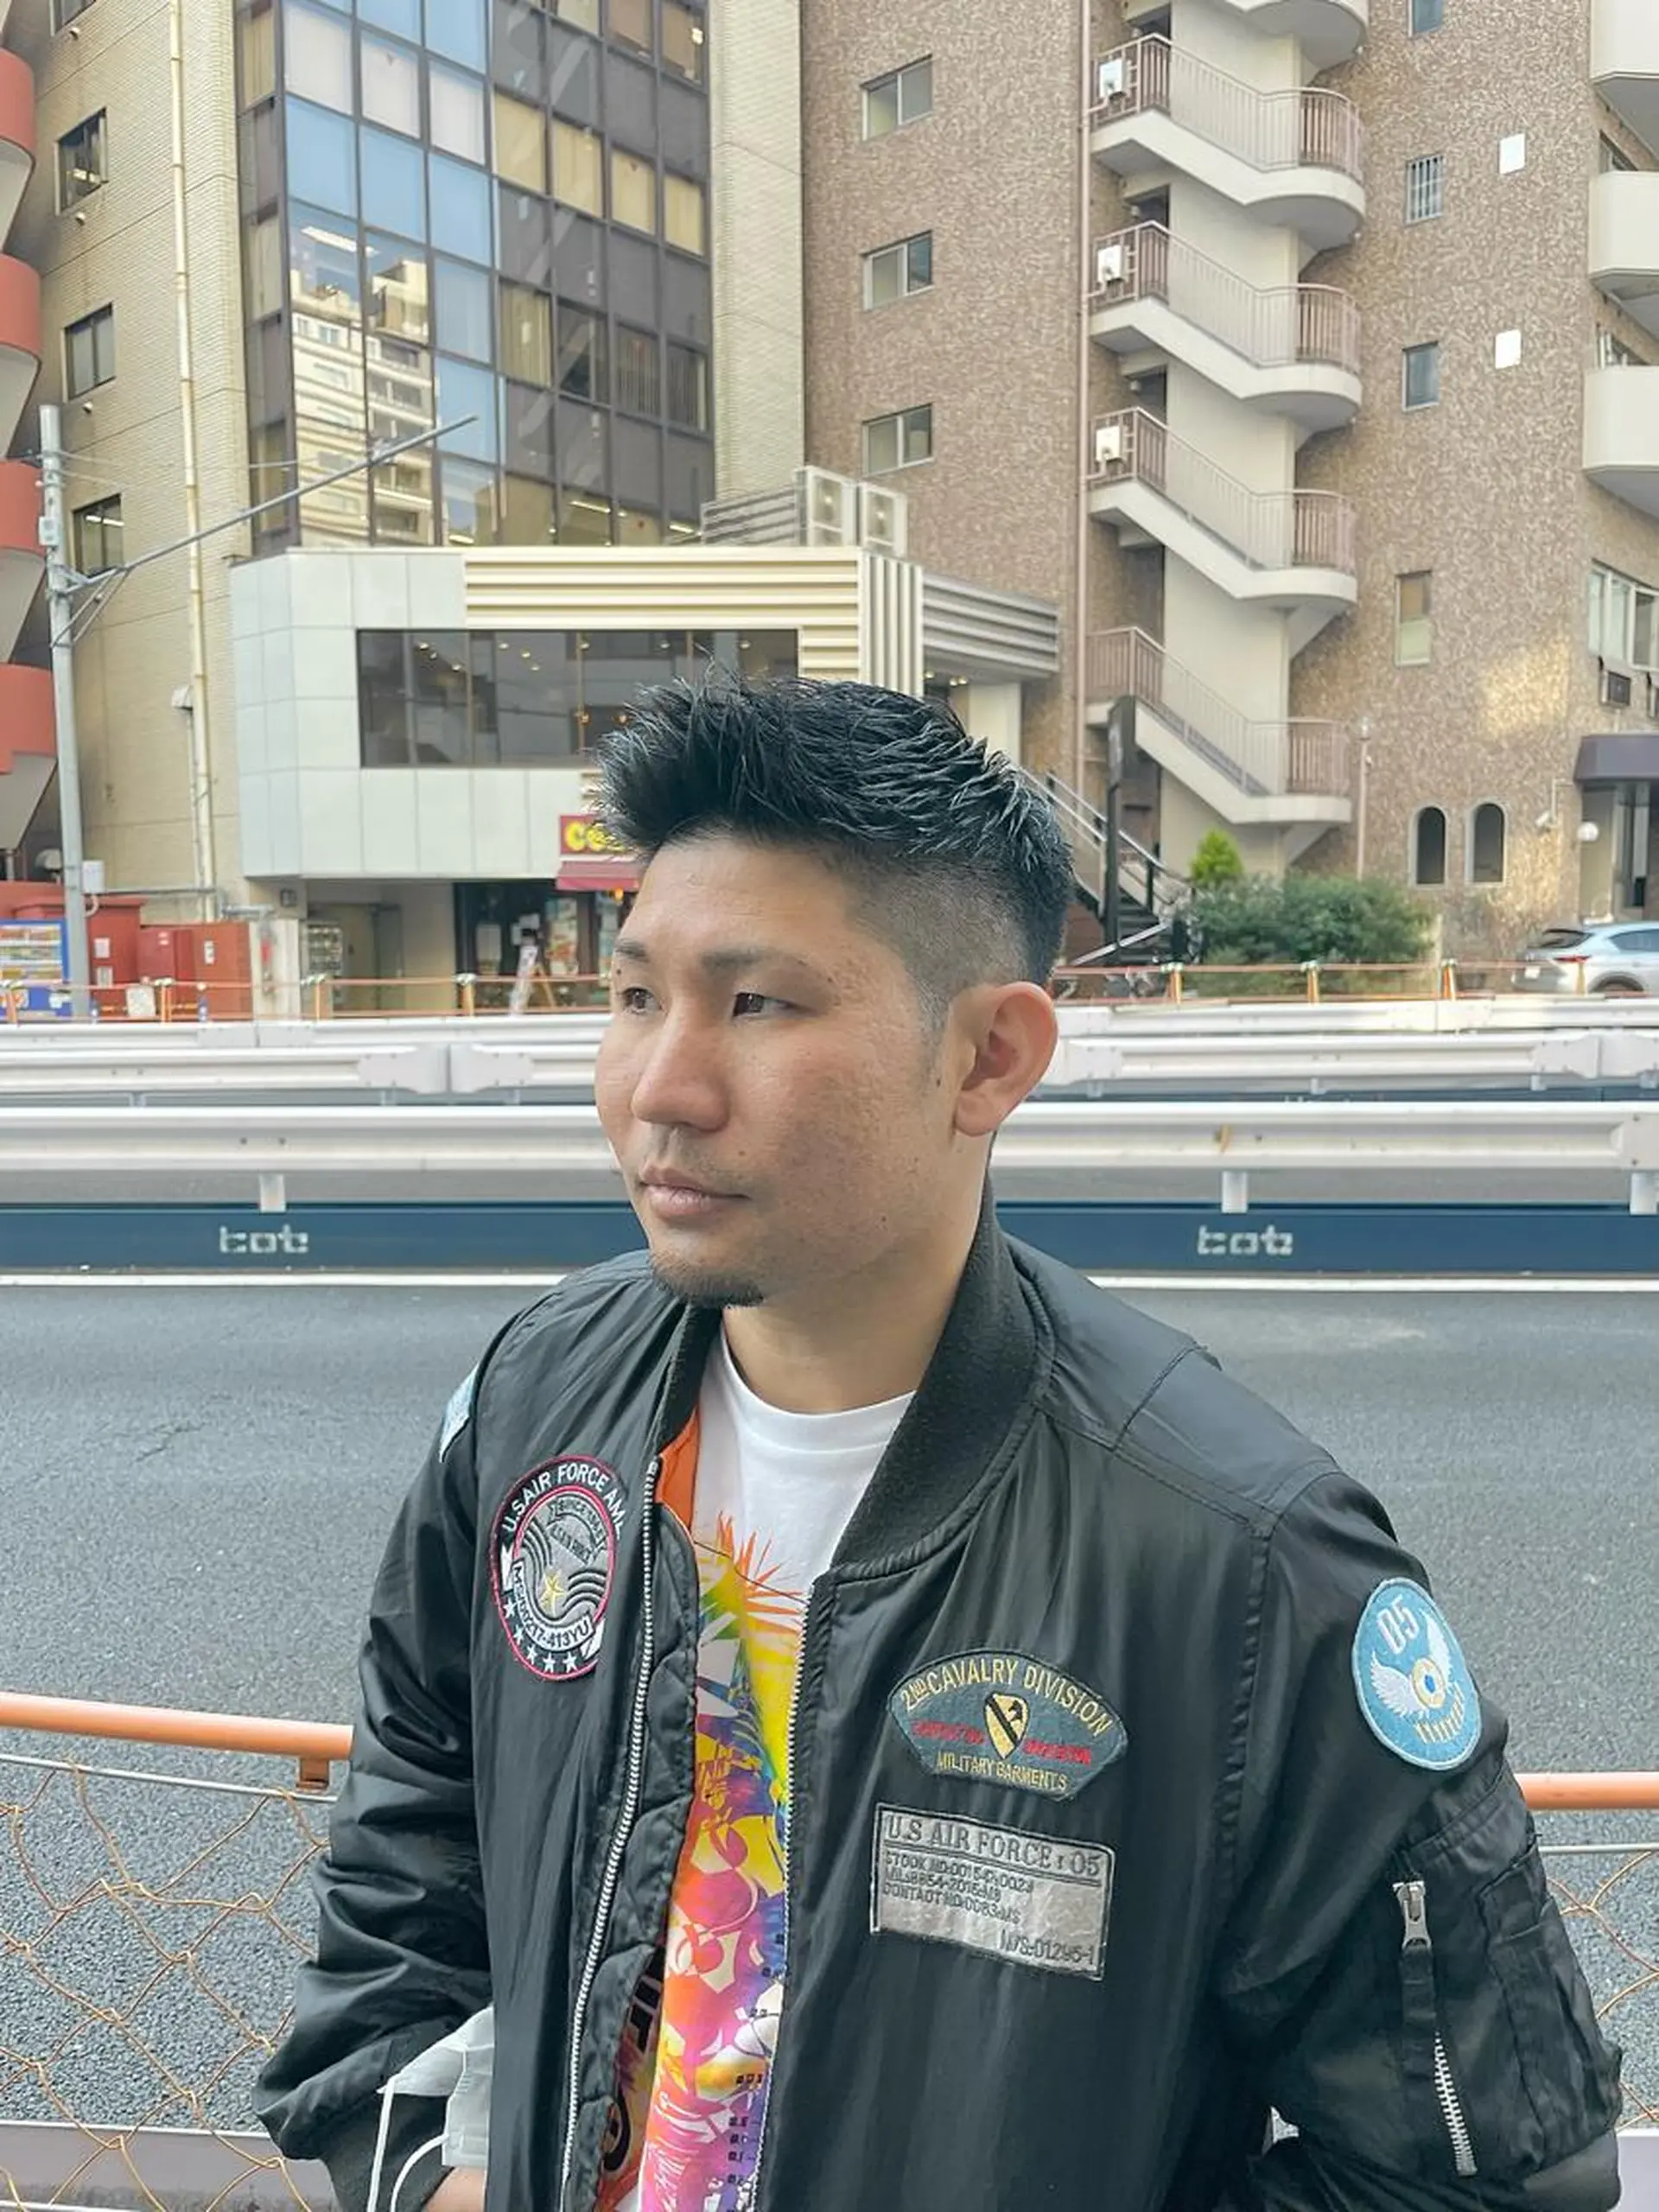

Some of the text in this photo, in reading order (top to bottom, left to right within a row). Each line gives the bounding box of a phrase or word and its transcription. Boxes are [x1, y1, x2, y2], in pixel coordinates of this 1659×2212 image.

[557, 1462, 610, 1492] FORCE
[900, 1677, 930, 1711] 2ND
[926, 1658, 1019, 1694] CAVALRY
[1023, 1665, 1114, 1738] DIVISION
[937, 1750, 994, 1777] MILITARY
[931, 1821, 970, 1852] AIR
[977, 1830, 1052, 1869] FORCE
[1071, 1850, 1103, 1877] 05
